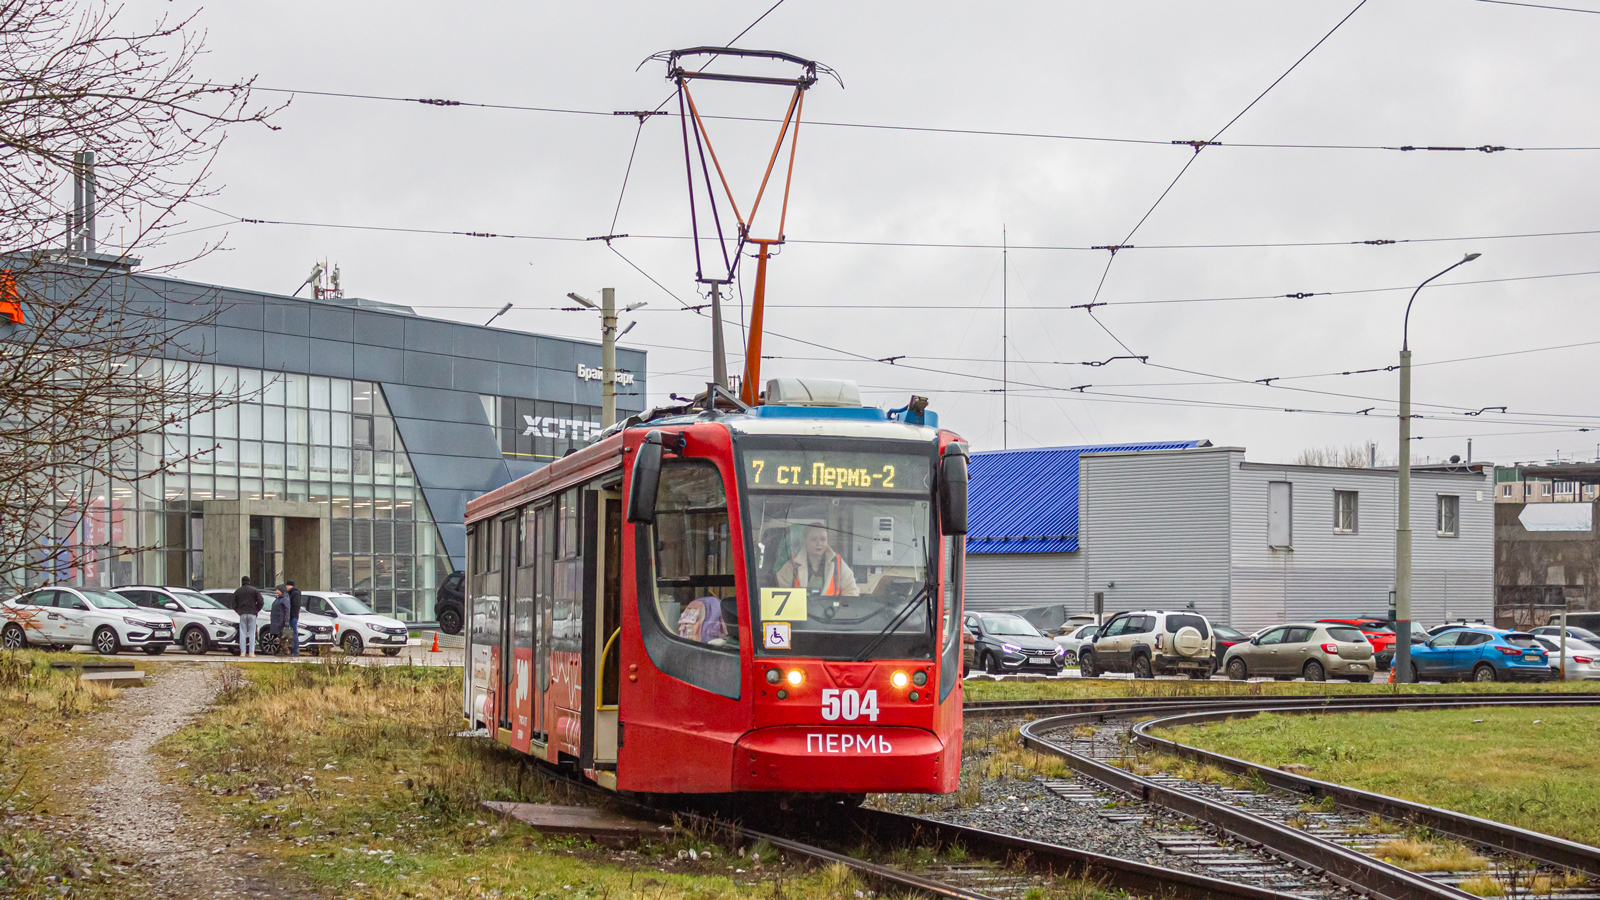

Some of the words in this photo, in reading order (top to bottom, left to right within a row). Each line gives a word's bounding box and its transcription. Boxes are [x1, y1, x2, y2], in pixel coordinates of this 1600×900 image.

[577, 363, 603, 381] Брай
[752, 460, 765, 483] 7
[771, 591, 791, 616] 7
[821, 688, 879, 722] 504
[806, 733, 893, 754] ПЕРМЬ
